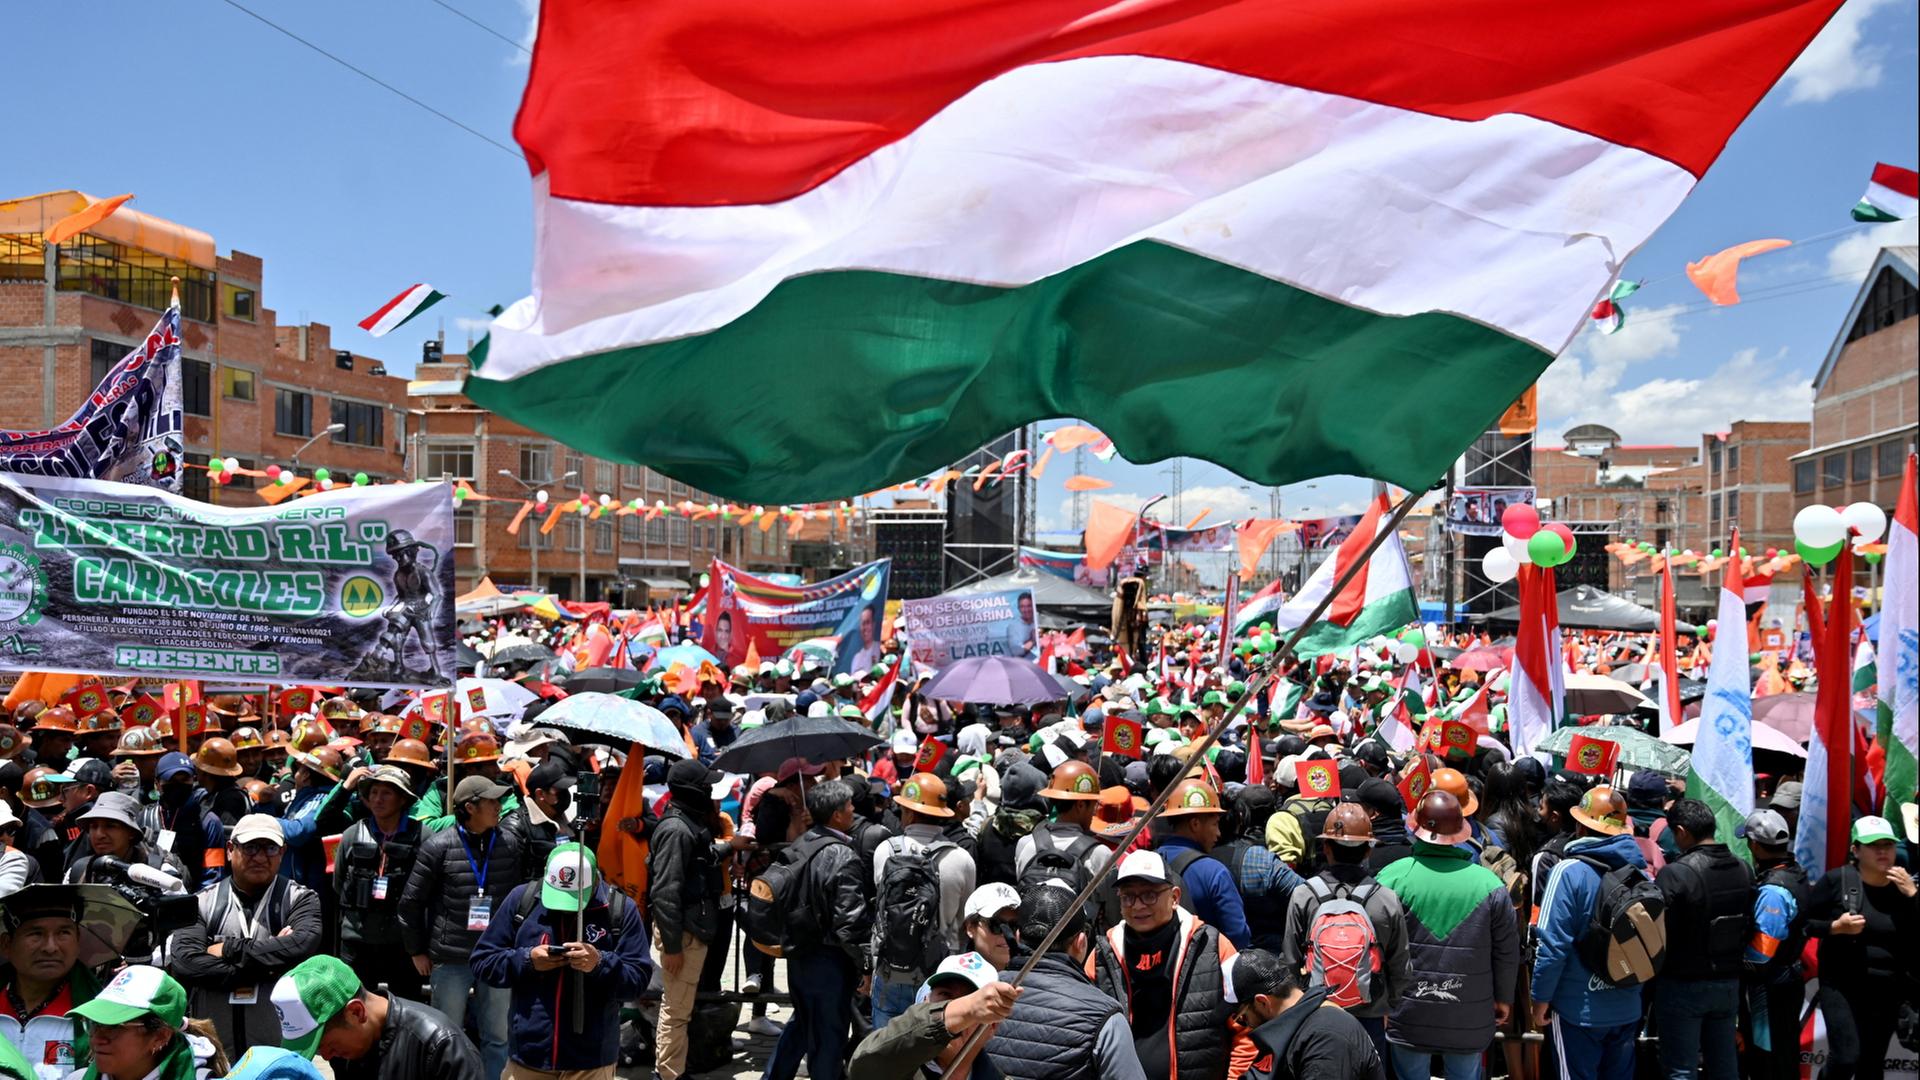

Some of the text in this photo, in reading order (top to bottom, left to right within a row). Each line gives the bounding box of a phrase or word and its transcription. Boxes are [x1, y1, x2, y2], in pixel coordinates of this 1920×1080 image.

[275, 522, 389, 566] R.L."
[74, 556, 327, 616] CARACOLES
[122, 607, 159, 616] FUNDADO
[160, 609, 171, 617] EL
[178, 610, 189, 618] DE
[190, 611, 238, 621] NOVIEMBRE
[240, 614, 250, 622] DE
[935, 596, 1010, 614] SECCIONAL
[111, 617, 147, 625] JURIDICA
[935, 615, 953, 628] DE
[955, 608, 1014, 625] HUARINA
[128, 627, 165, 635] CENTRAL
[166, 629, 212, 638] CARACOLES
[213, 630, 257, 641] FEDECOMIN
[117, 647, 279, 673] PRESENTE
[951, 640, 1005, 660] LARA
